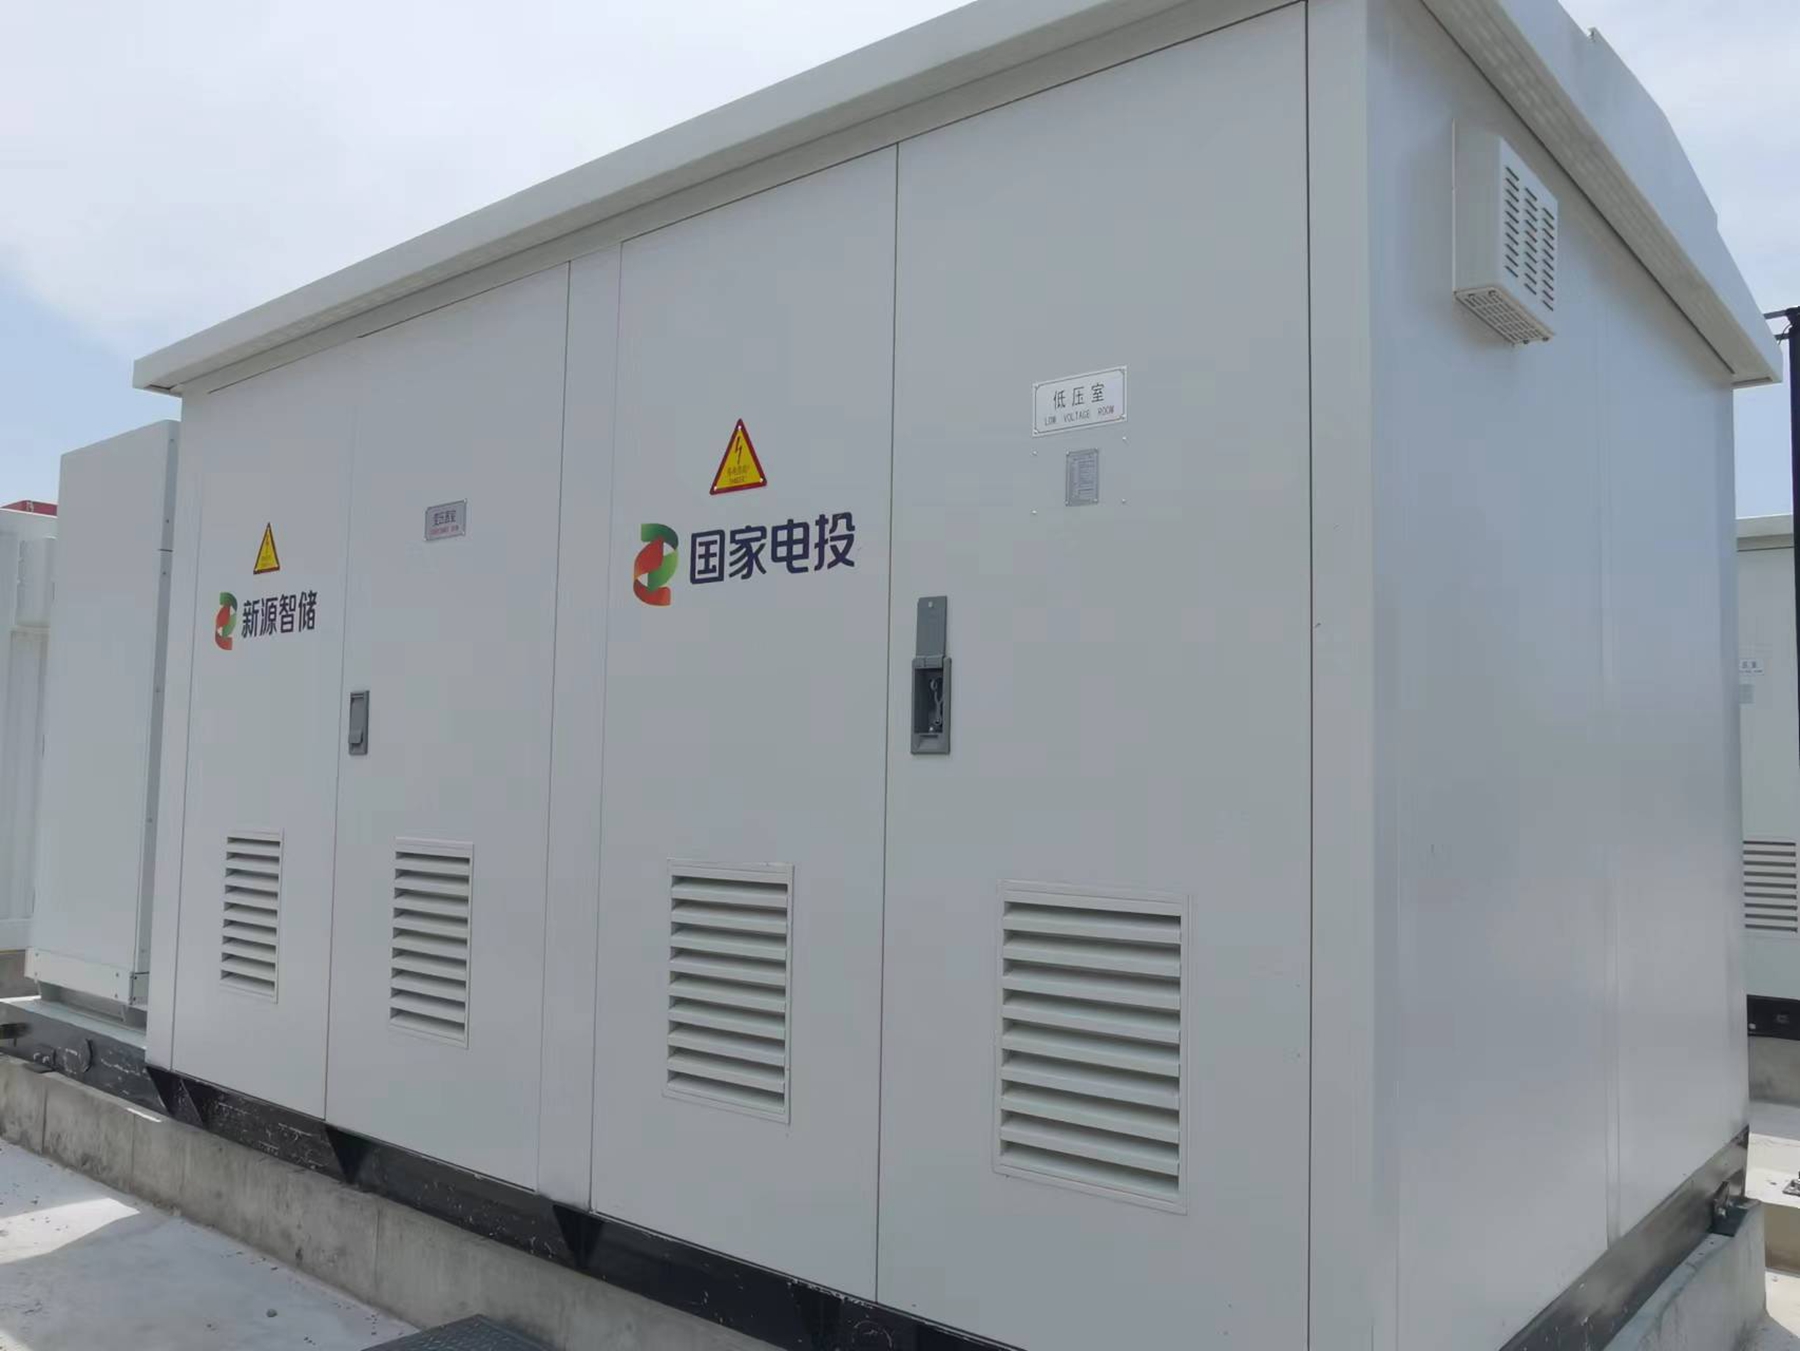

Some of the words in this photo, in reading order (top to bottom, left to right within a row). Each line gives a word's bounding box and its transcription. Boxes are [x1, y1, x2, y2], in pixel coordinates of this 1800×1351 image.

[1053, 382, 1105, 410] 低压室
[1063, 409, 1090, 422] VOLTAGE
[690, 511, 856, 585] 国家电投
[241, 590, 318, 638] 新源智储
